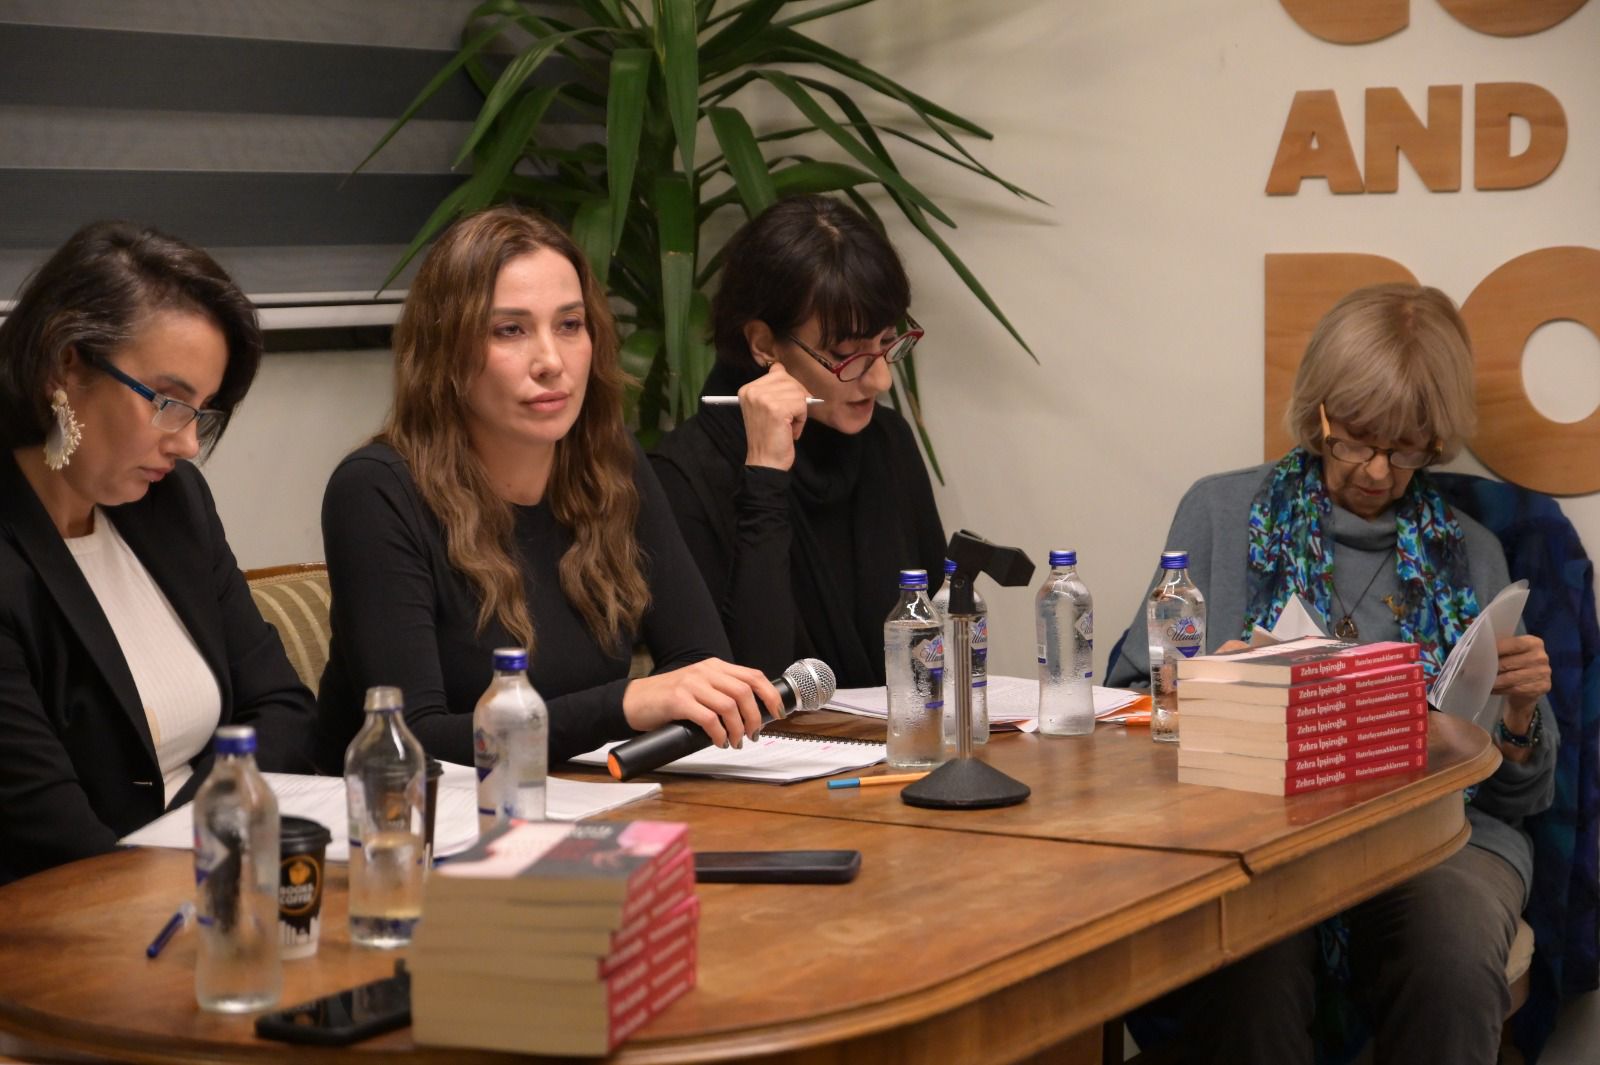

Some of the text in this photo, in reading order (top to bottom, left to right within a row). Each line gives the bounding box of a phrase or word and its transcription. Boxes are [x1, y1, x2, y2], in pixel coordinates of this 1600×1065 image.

[1265, 82, 1568, 196] AND
[1300, 667, 1318, 677] Zehra
[1298, 688, 1317, 699] Zehra
[1296, 707, 1316, 717] Zehra
[1297, 725, 1316, 735] Zehra
[1298, 742, 1318, 752] Zehra
[1296, 760, 1316, 770] Zehra
[1295, 778, 1315, 788] Zehra
